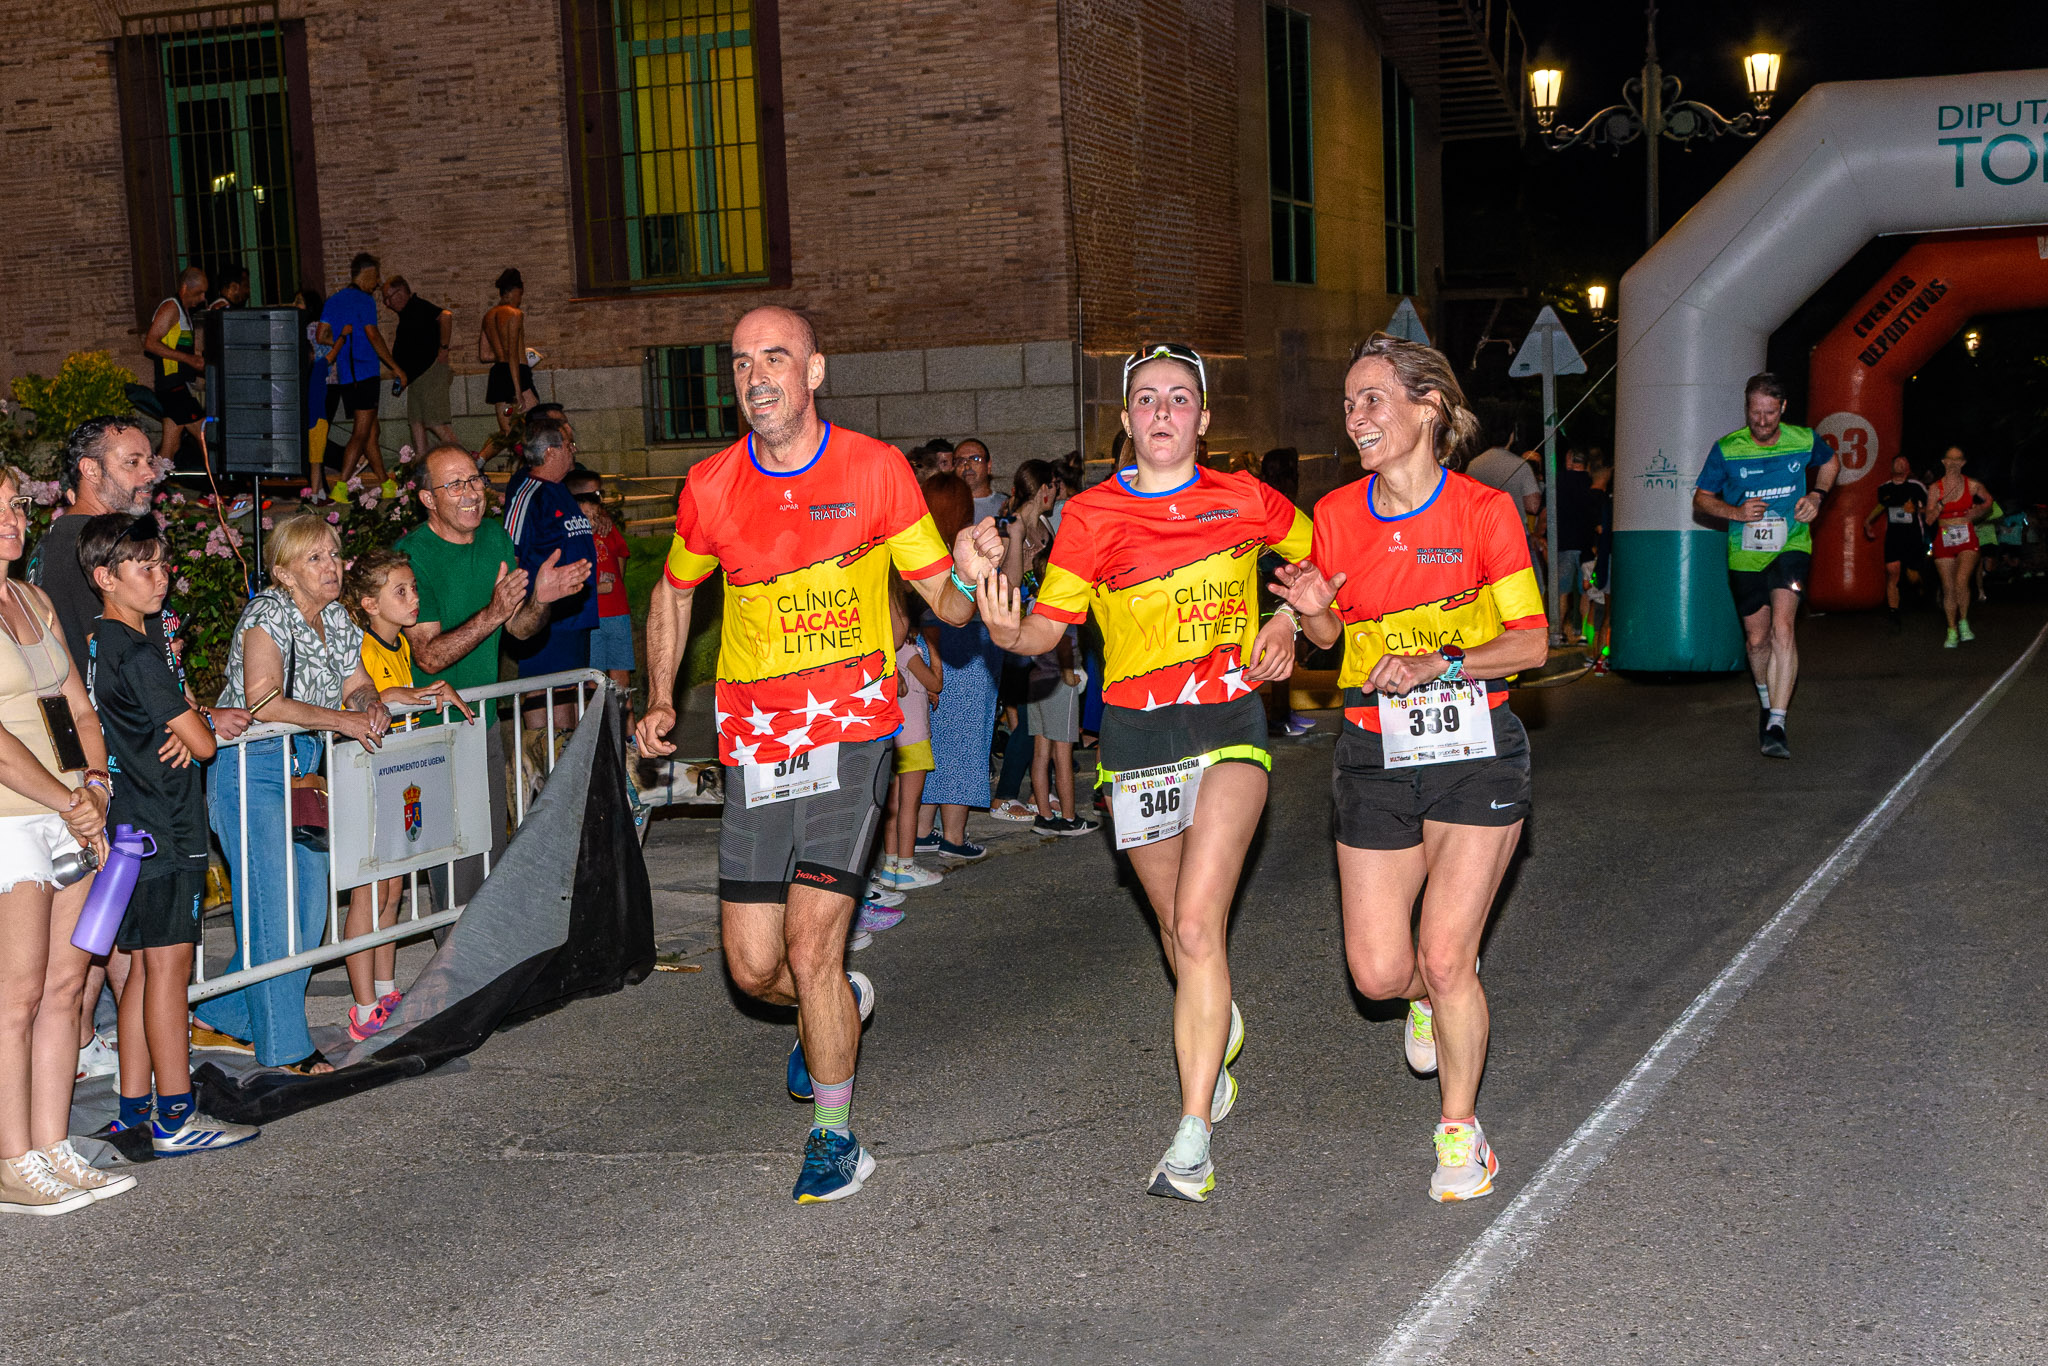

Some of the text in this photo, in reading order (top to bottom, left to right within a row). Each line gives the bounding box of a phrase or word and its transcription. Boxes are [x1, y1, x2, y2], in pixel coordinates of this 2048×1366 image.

[1938, 99, 2048, 131] DIPUT
[1938, 132, 2048, 188] TO
[1857, 278, 1948, 367] DEPORTIVOS
[564, 516, 592, 531] adida
[1754, 528, 1774, 540] 421
[776, 586, 860, 613] CLÍNICA
[1174, 579, 1245, 605] CLÍNICA
[779, 607, 861, 633] LACASA
[1177, 600, 1248, 624] LACASA
[784, 627, 864, 654] LITNER
[1177, 617, 1248, 644] LITNER
[1385, 627, 1464, 651] CLÍNICA
[1409, 705, 1460, 736] 339
[378, 755, 446, 777] AYUNTAMIENTO DE UGENA
[774, 751, 810, 778] 374
[1120, 772, 1141, 782] LEGUA
[1141, 765, 1177, 777] NOCTURNA
[1177, 759, 1200, 771] UGENA
[1140, 787, 1181, 818] 346
